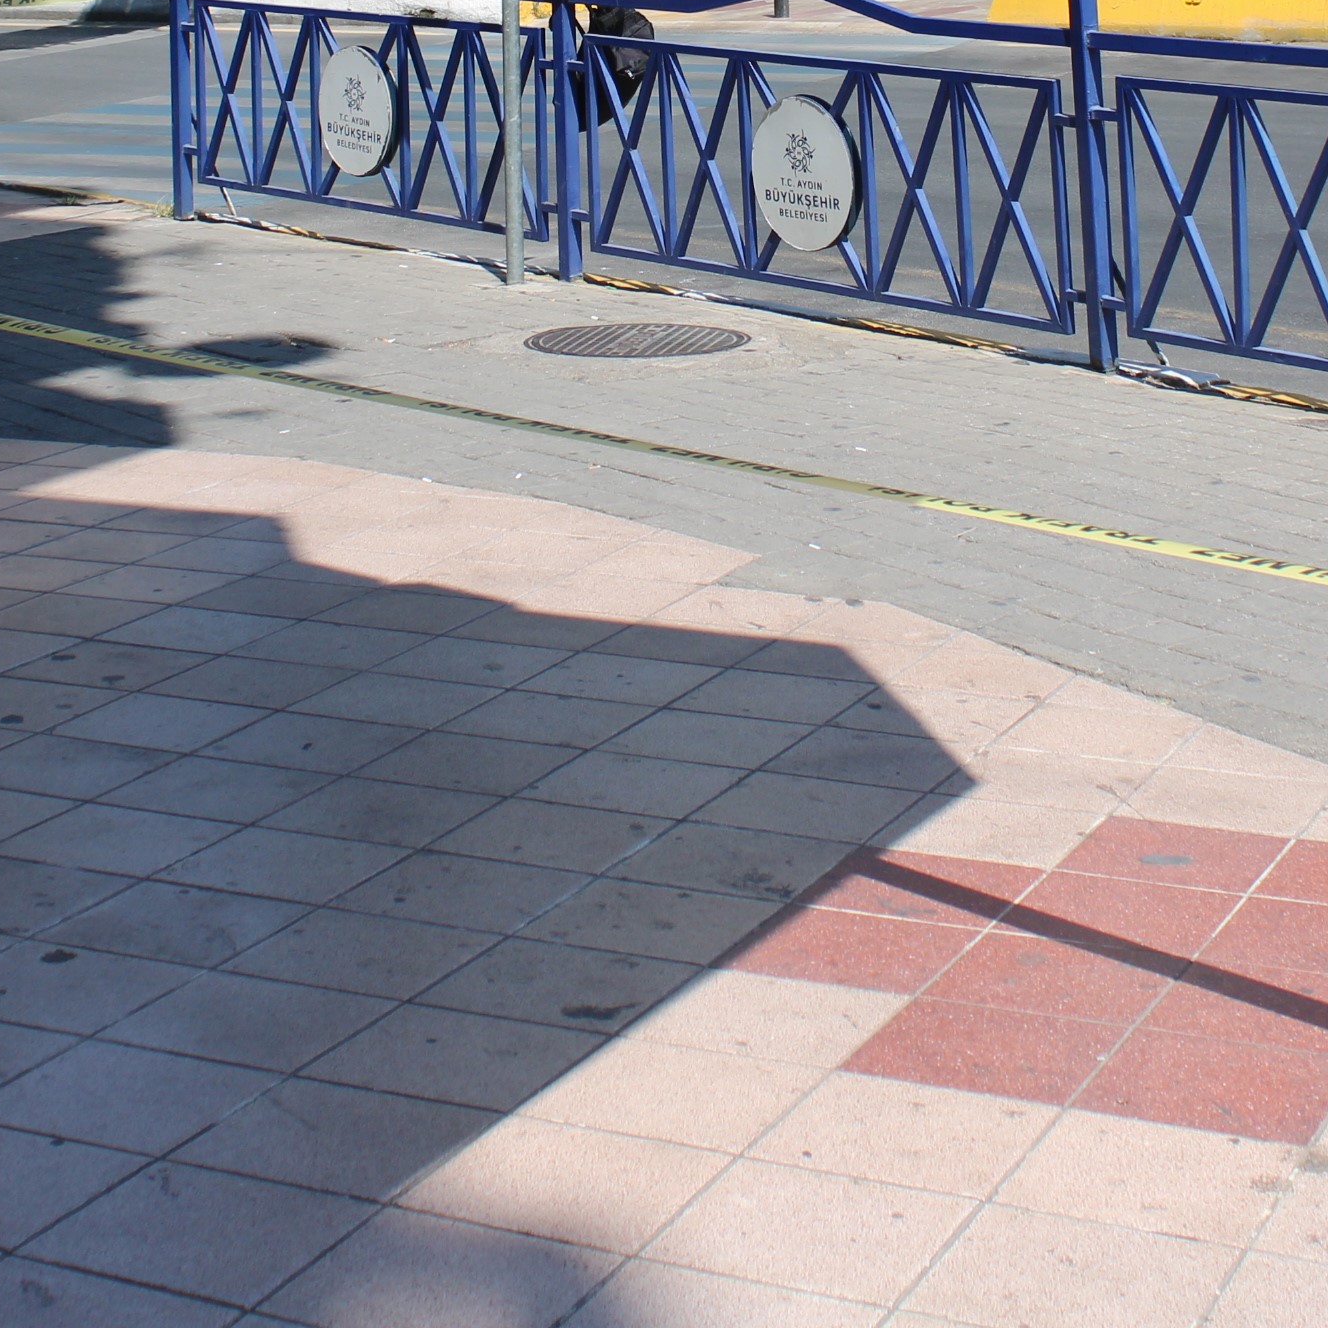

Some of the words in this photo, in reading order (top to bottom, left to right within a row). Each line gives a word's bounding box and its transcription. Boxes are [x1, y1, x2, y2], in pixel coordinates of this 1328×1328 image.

[339, 112, 349, 122] T.C.
[352, 118, 371, 127] AYDIN
[328, 122, 382, 144] BÜYÜKŞEHİR
[337, 139, 372, 154] BELEDİYESİ
[780, 178, 793, 188] T.C.
[797, 180, 823, 190] AYDIN
[765, 188, 840, 211] BÜYÜKŞEHİR
[779, 208, 828, 223] BELEDİYESİ
